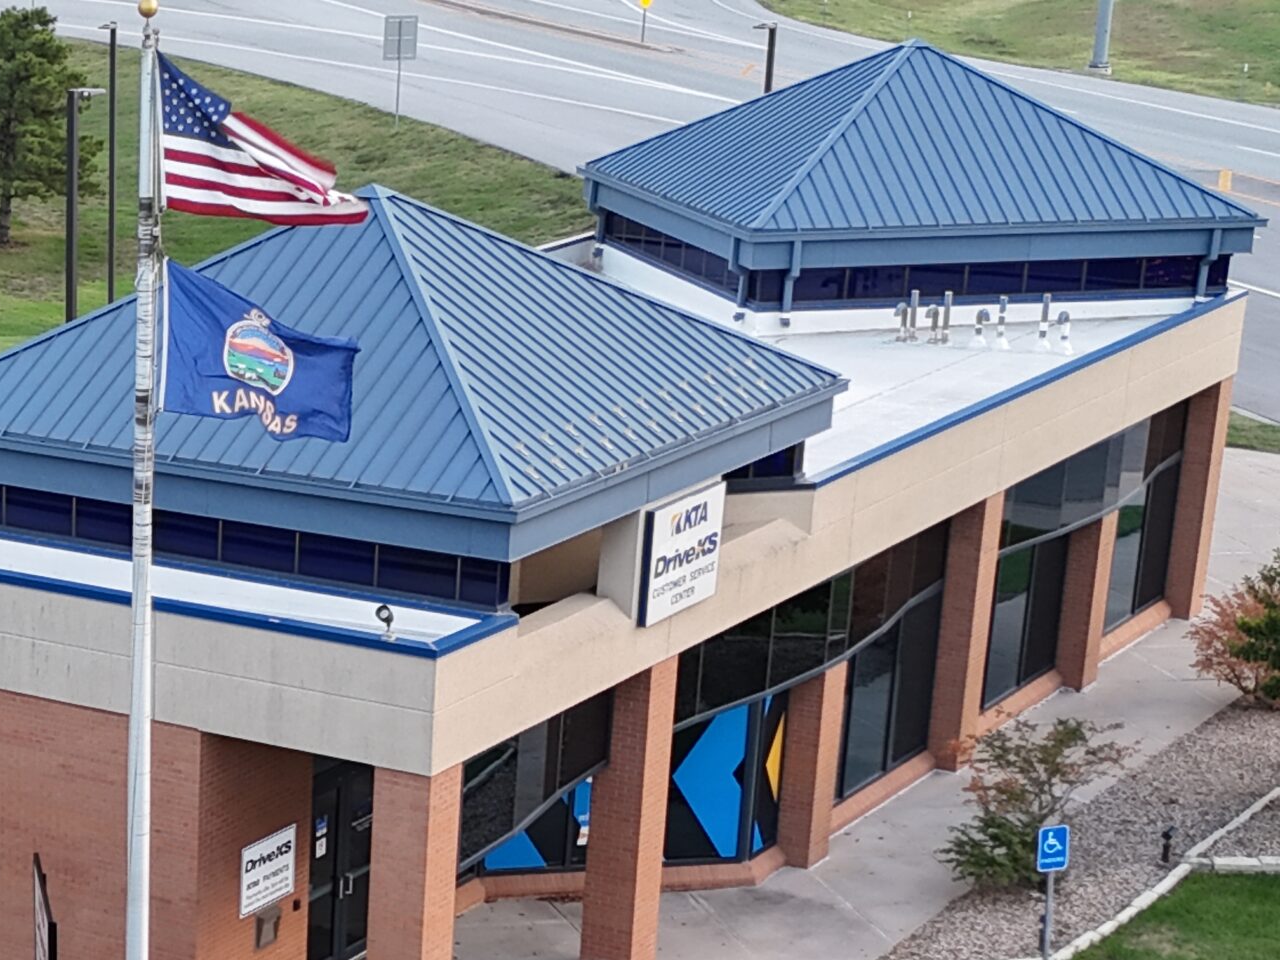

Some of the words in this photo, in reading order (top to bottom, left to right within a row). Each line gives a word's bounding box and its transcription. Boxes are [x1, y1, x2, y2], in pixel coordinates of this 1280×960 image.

[212, 388, 298, 434] KANSAS
[683, 501, 708, 531] KTA
[654, 532, 718, 579] DriveKS
[671, 586, 696, 605] CENTER
[245, 840, 292, 874] DriveKS
